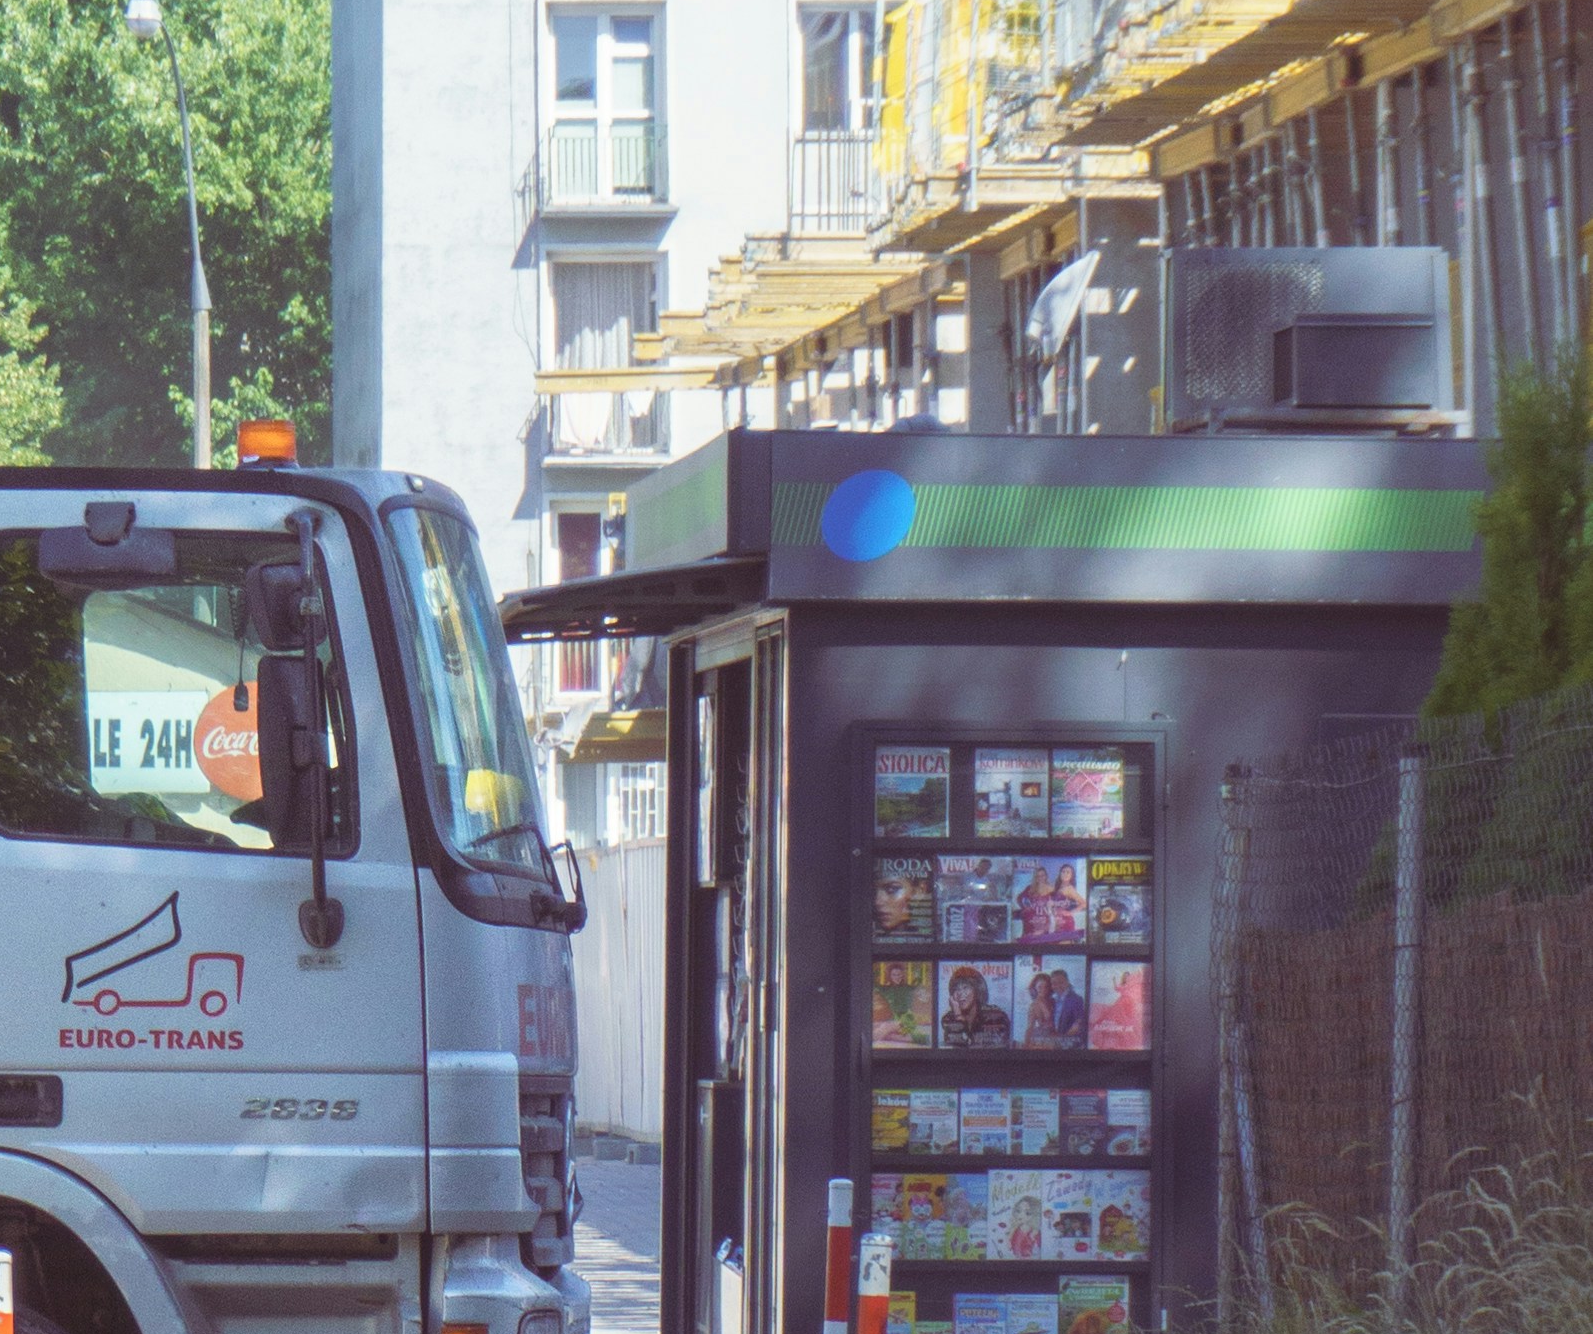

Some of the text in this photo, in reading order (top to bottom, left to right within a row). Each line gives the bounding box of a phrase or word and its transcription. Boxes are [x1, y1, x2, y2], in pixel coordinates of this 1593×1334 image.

[139, 719, 193, 768] 24H
[877, 754, 947, 773] STOLICA
[873, 858, 933, 872] RODA
[1092, 861, 1146, 880] ODKRYW
[59, 1028, 244, 1050] EURO-TRANS
